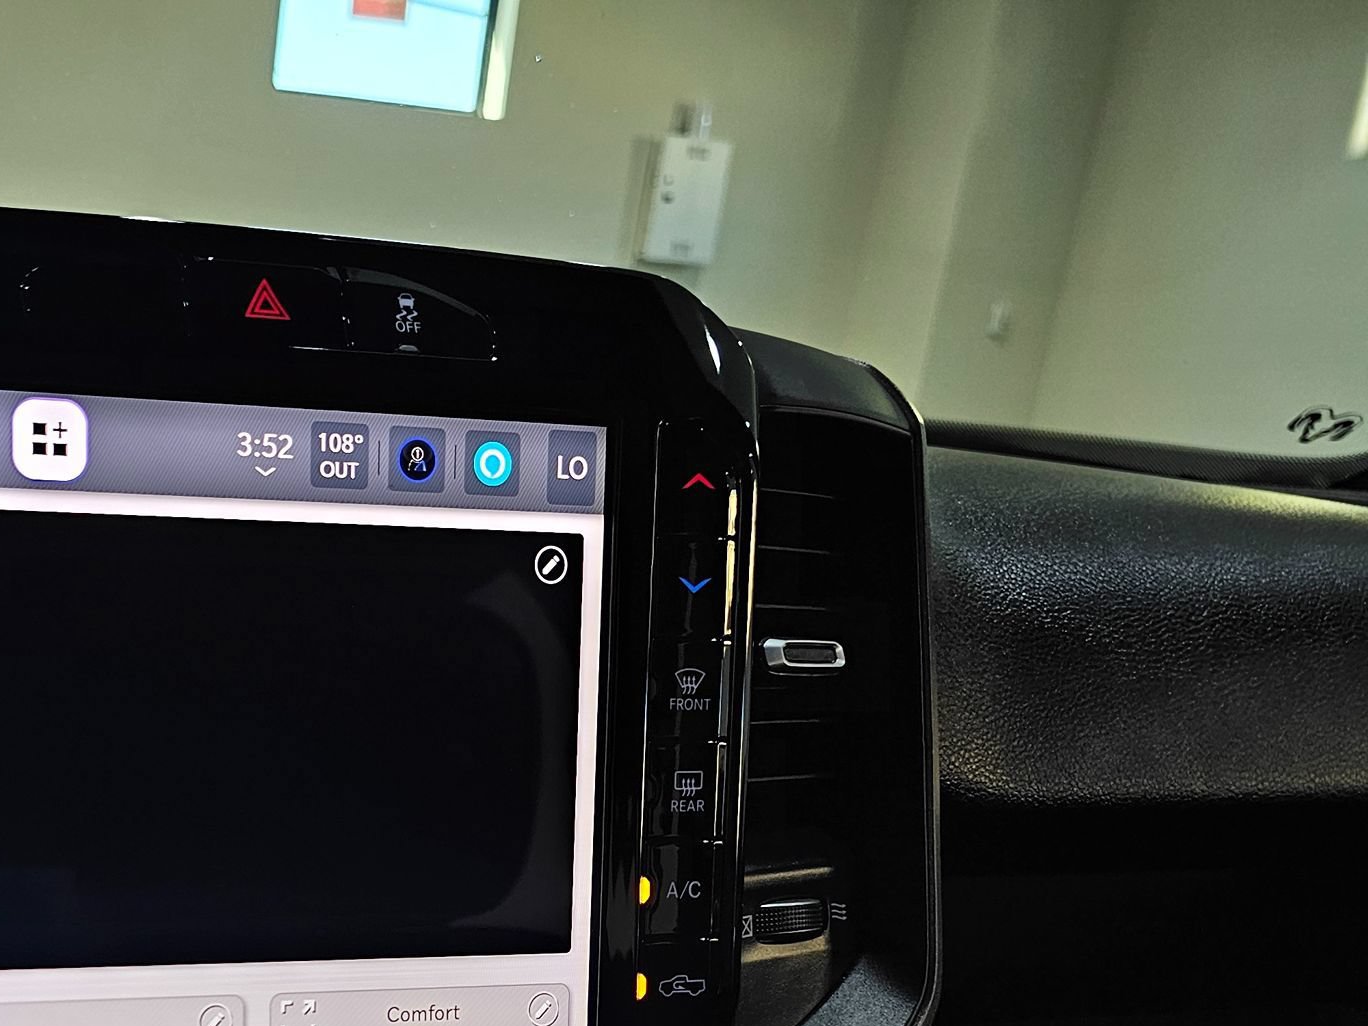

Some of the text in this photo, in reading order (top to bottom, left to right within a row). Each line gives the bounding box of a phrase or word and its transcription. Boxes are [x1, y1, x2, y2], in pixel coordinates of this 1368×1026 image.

[395, 321, 422, 334] OFF
[236, 431, 294, 460] 3:52
[318, 432, 365, 454] 108°
[319, 460, 360, 480] OUT
[557, 454, 589, 481] LO
[669, 697, 711, 711] FRONT
[670, 799, 705, 813] REAR
[666, 880, 702, 899] A/C
[387, 1004, 460, 1023] Comfort
